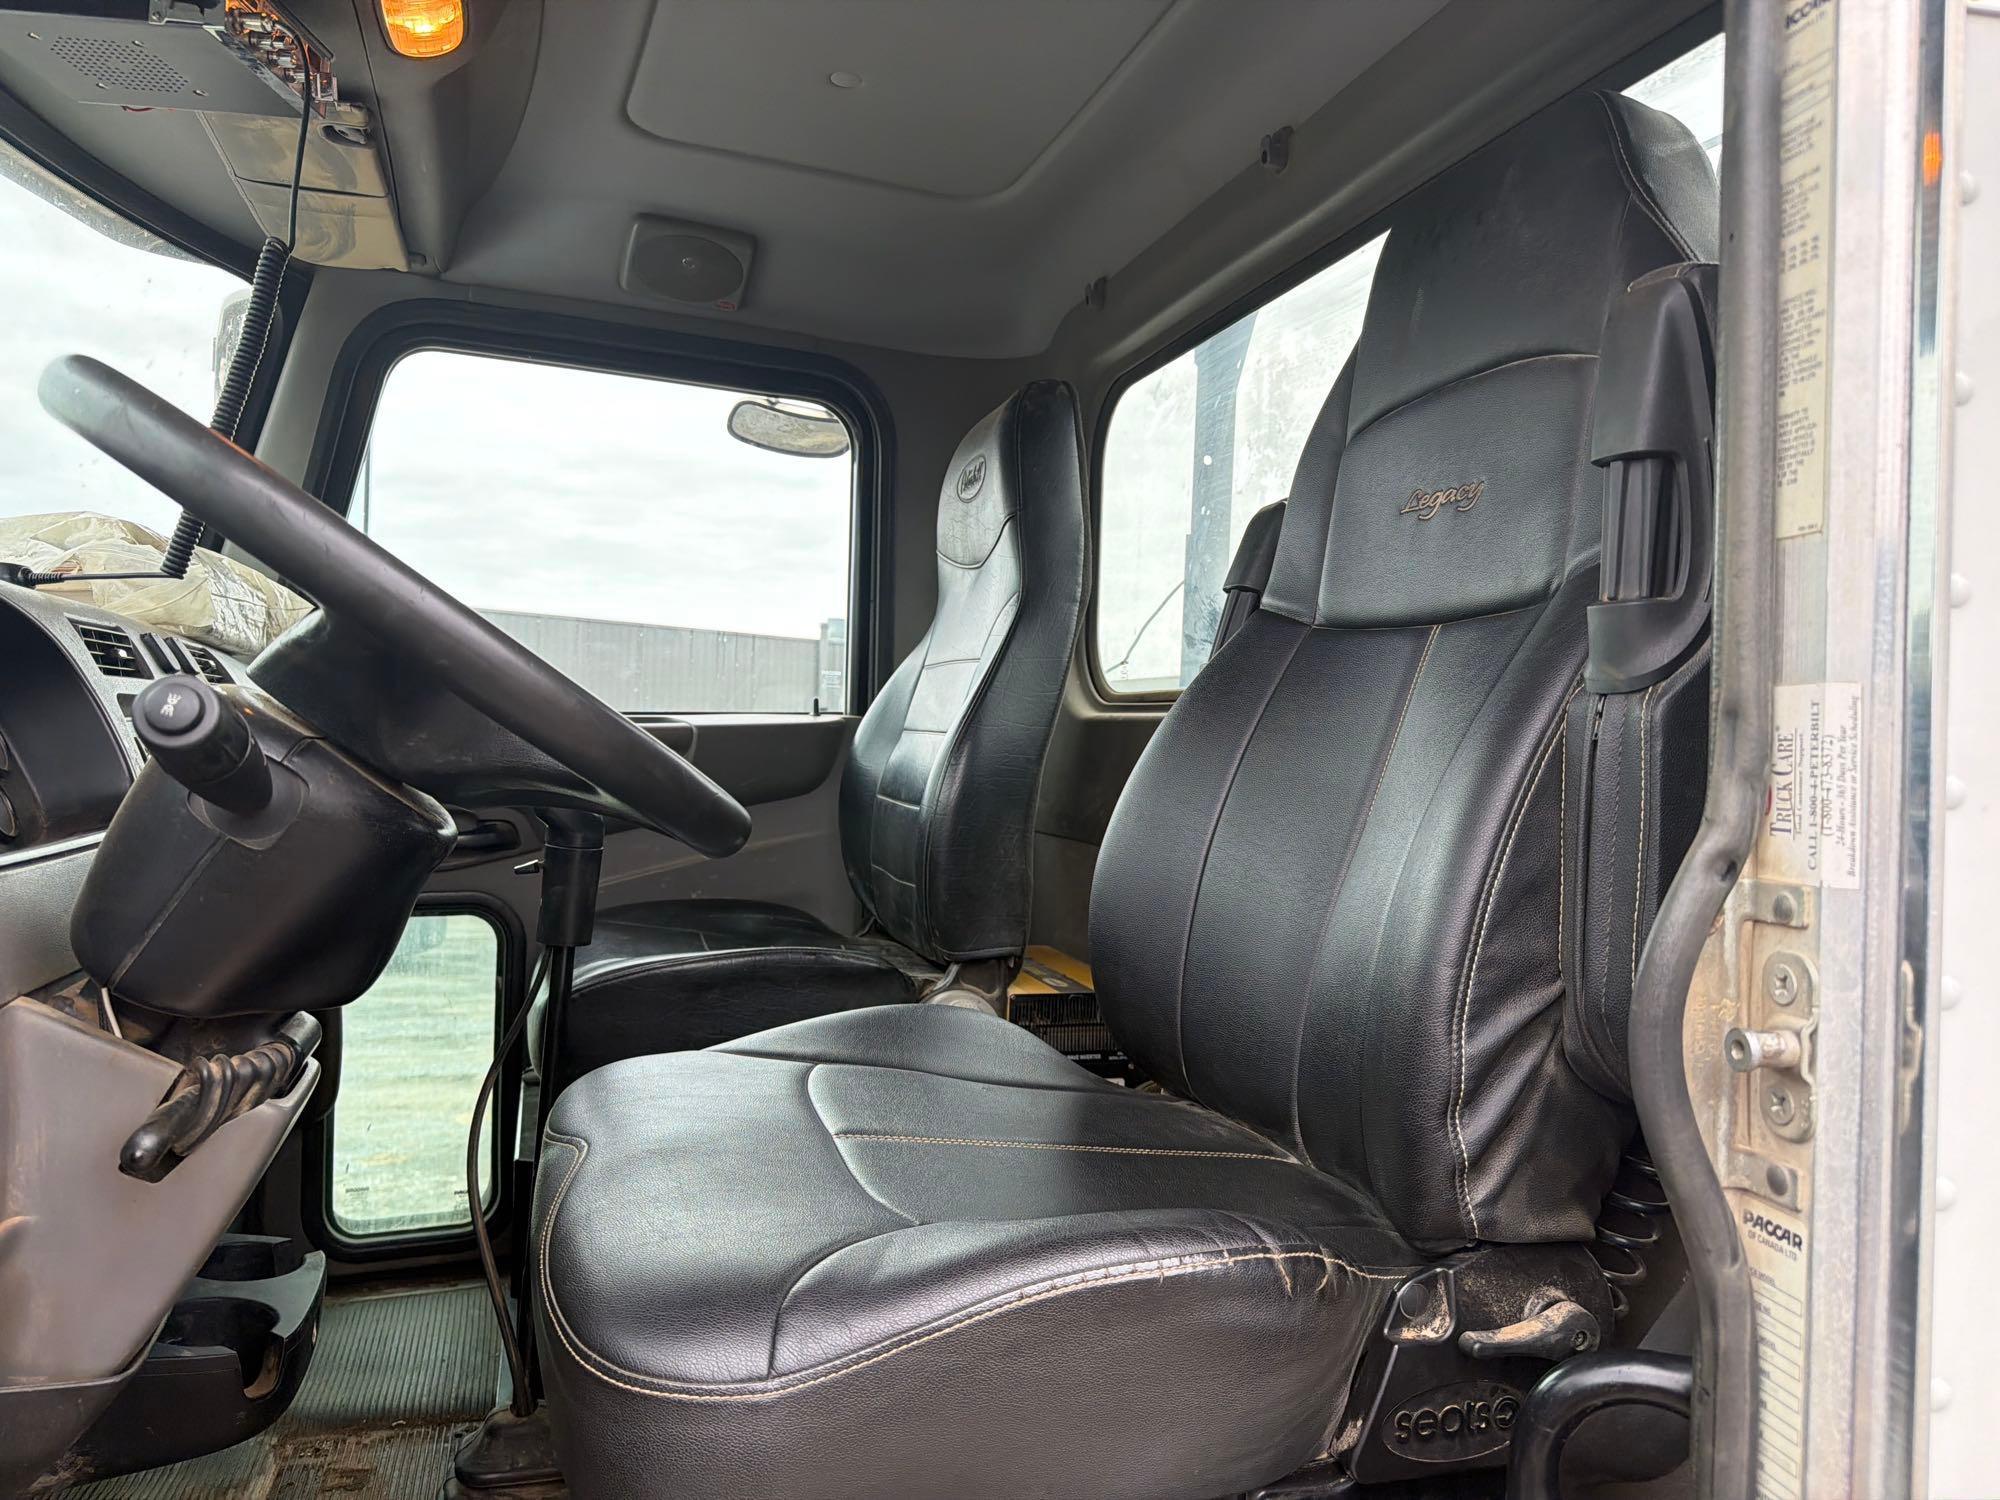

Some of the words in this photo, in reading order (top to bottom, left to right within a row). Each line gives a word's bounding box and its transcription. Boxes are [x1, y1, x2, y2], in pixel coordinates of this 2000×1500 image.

[1400, 480, 1485, 520] Legacy
[1770, 732, 1794, 776] CARE
[1769, 781, 1793, 837] TRUCK
[1808, 831, 1817, 871] CALL
[1742, 1208, 1803, 1252] PACCAR
[1757, 1234, 1784, 1256] CANADA
